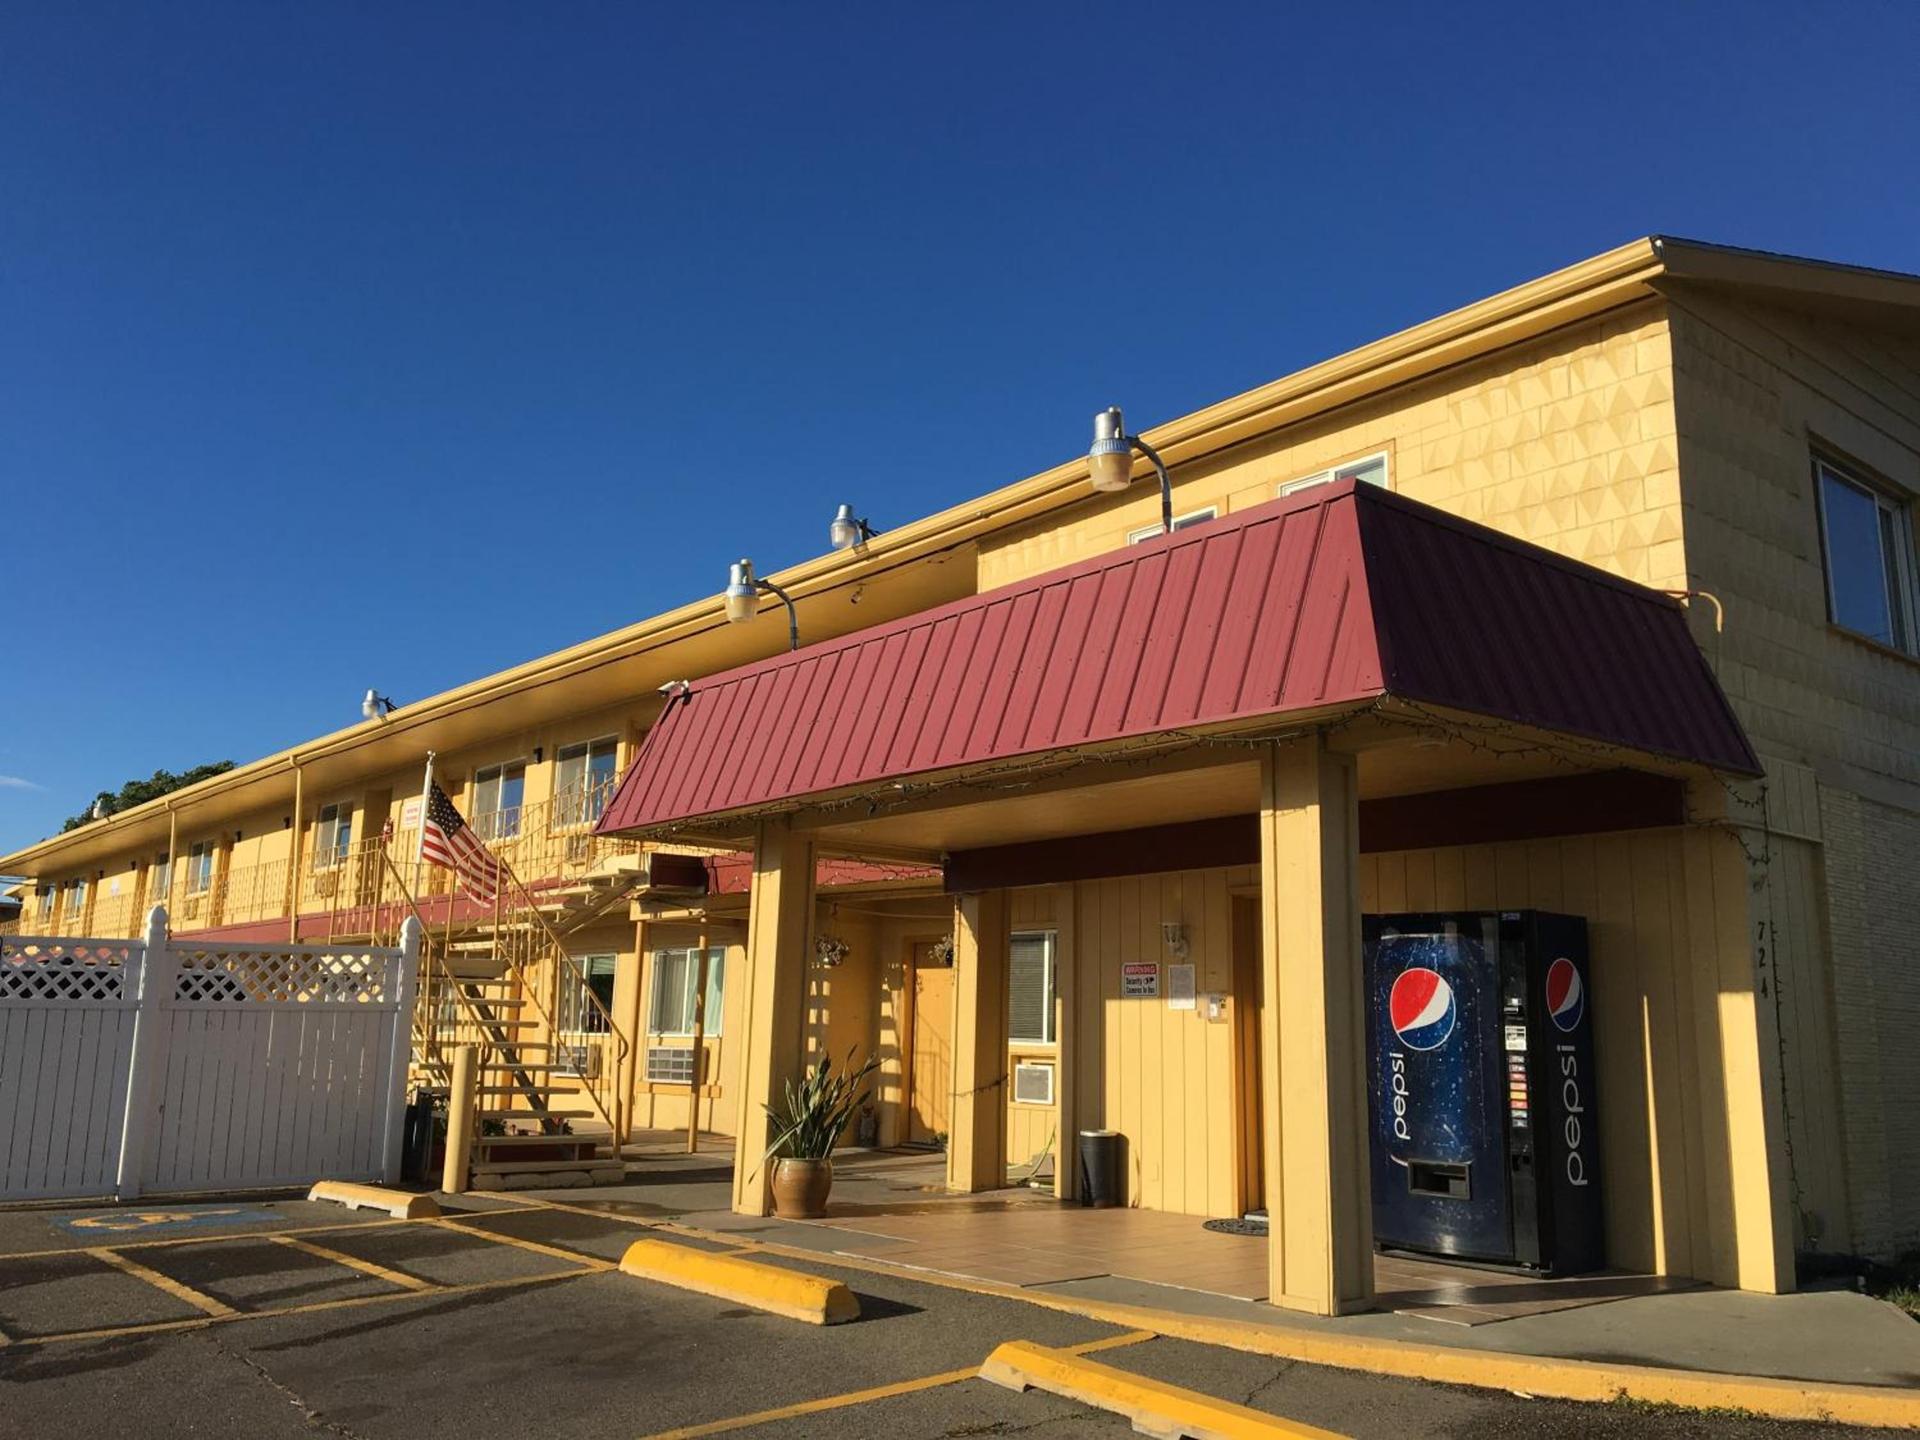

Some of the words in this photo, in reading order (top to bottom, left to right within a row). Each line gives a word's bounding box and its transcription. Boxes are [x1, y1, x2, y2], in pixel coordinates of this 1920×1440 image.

[1758, 921, 1768, 998] 724
[1389, 1052, 1411, 1140] pepsi
[1557, 1044, 1588, 1186] pepsi
